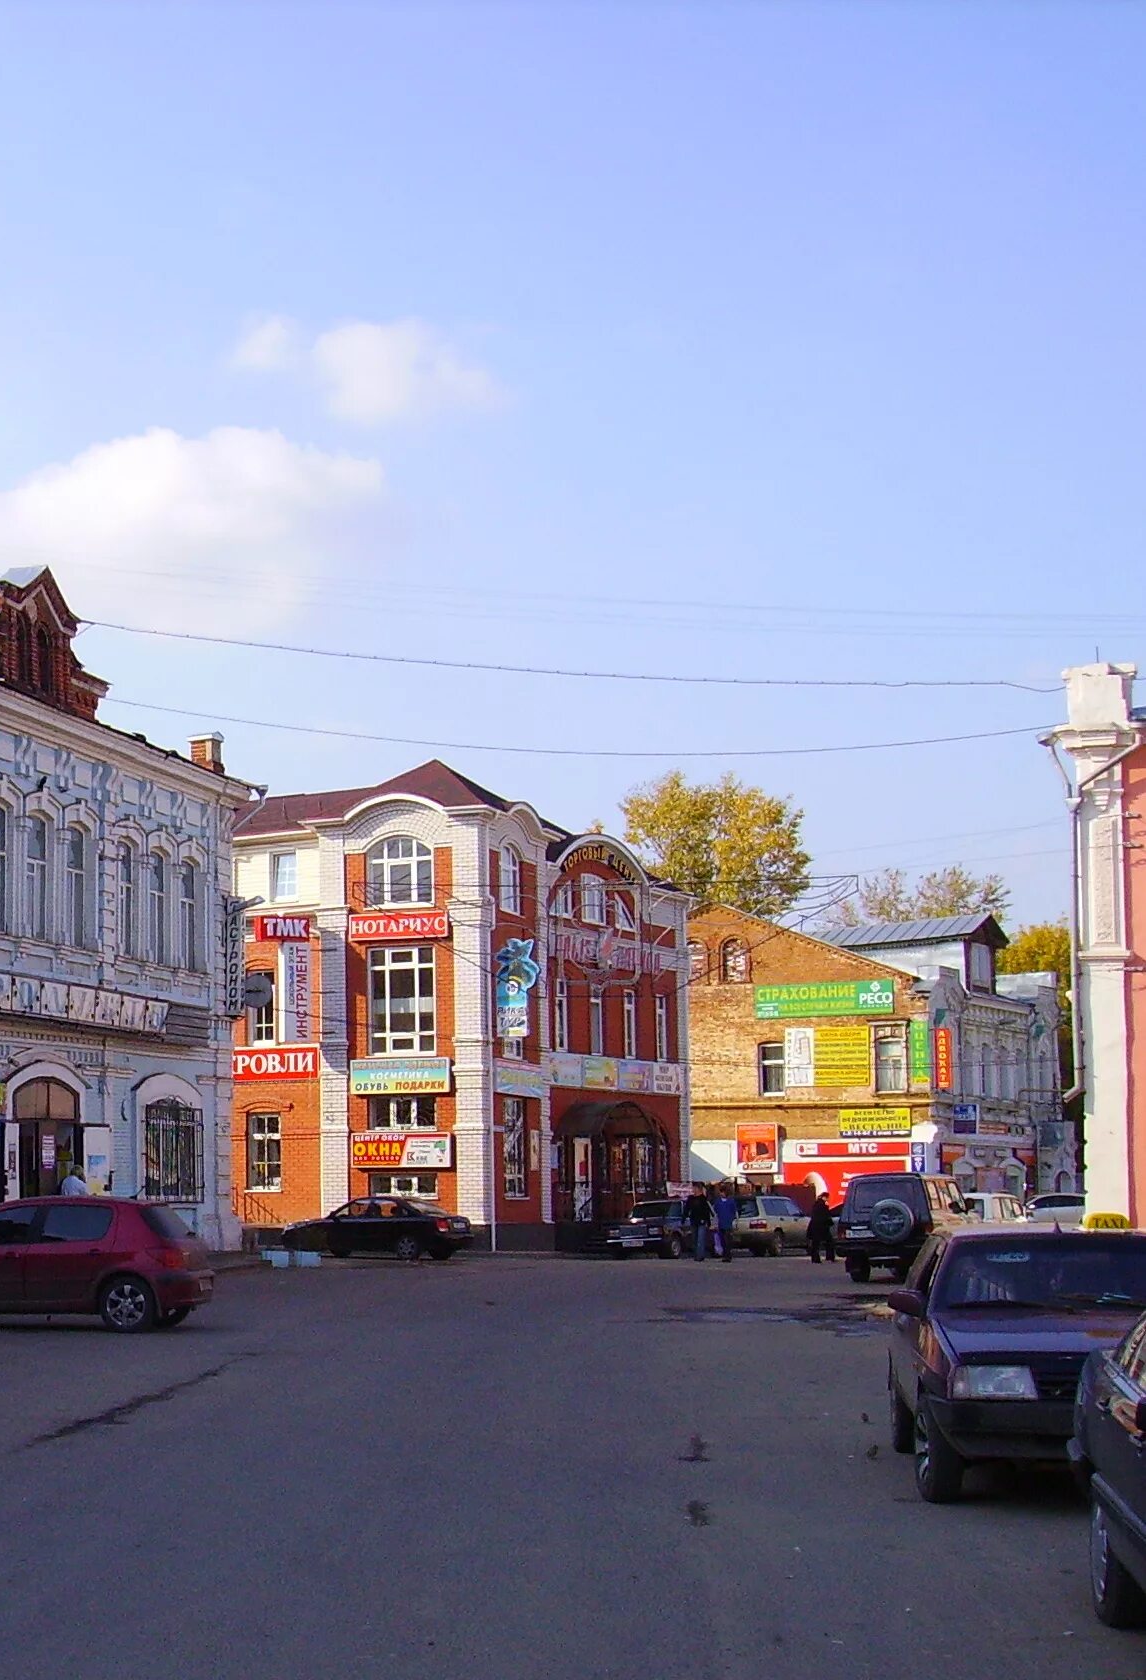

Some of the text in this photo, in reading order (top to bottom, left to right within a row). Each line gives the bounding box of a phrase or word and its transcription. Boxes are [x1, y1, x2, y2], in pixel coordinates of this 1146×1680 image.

[562, 845, 609, 872] ТОРГОВЫЙ
[264, 918, 308, 938] ТМК
[351, 916, 446, 935] НОТАРИУС
[228, 901, 239, 1012] ГАСТРОНОМ
[296, 946, 308, 1039] ИНСТРУМЕНТ
[757, 984, 856, 1001] СТРАХОВАНИЕ
[859, 992, 893, 1005] РЕСО
[912, 1022, 926, 1077] ОЦЕНКА
[937, 1030, 948, 1083] АДВОКАТ
[369, 1071, 430, 1080] КОСМЕТИКА
[355, 1080, 445, 1091] ОБУВЬ ПОДАРКИ
[354, 1142, 402, 1156] ОКНА
[847, 1143, 878, 1154] МТС
[1093, 1217, 1125, 1229] TAXI
